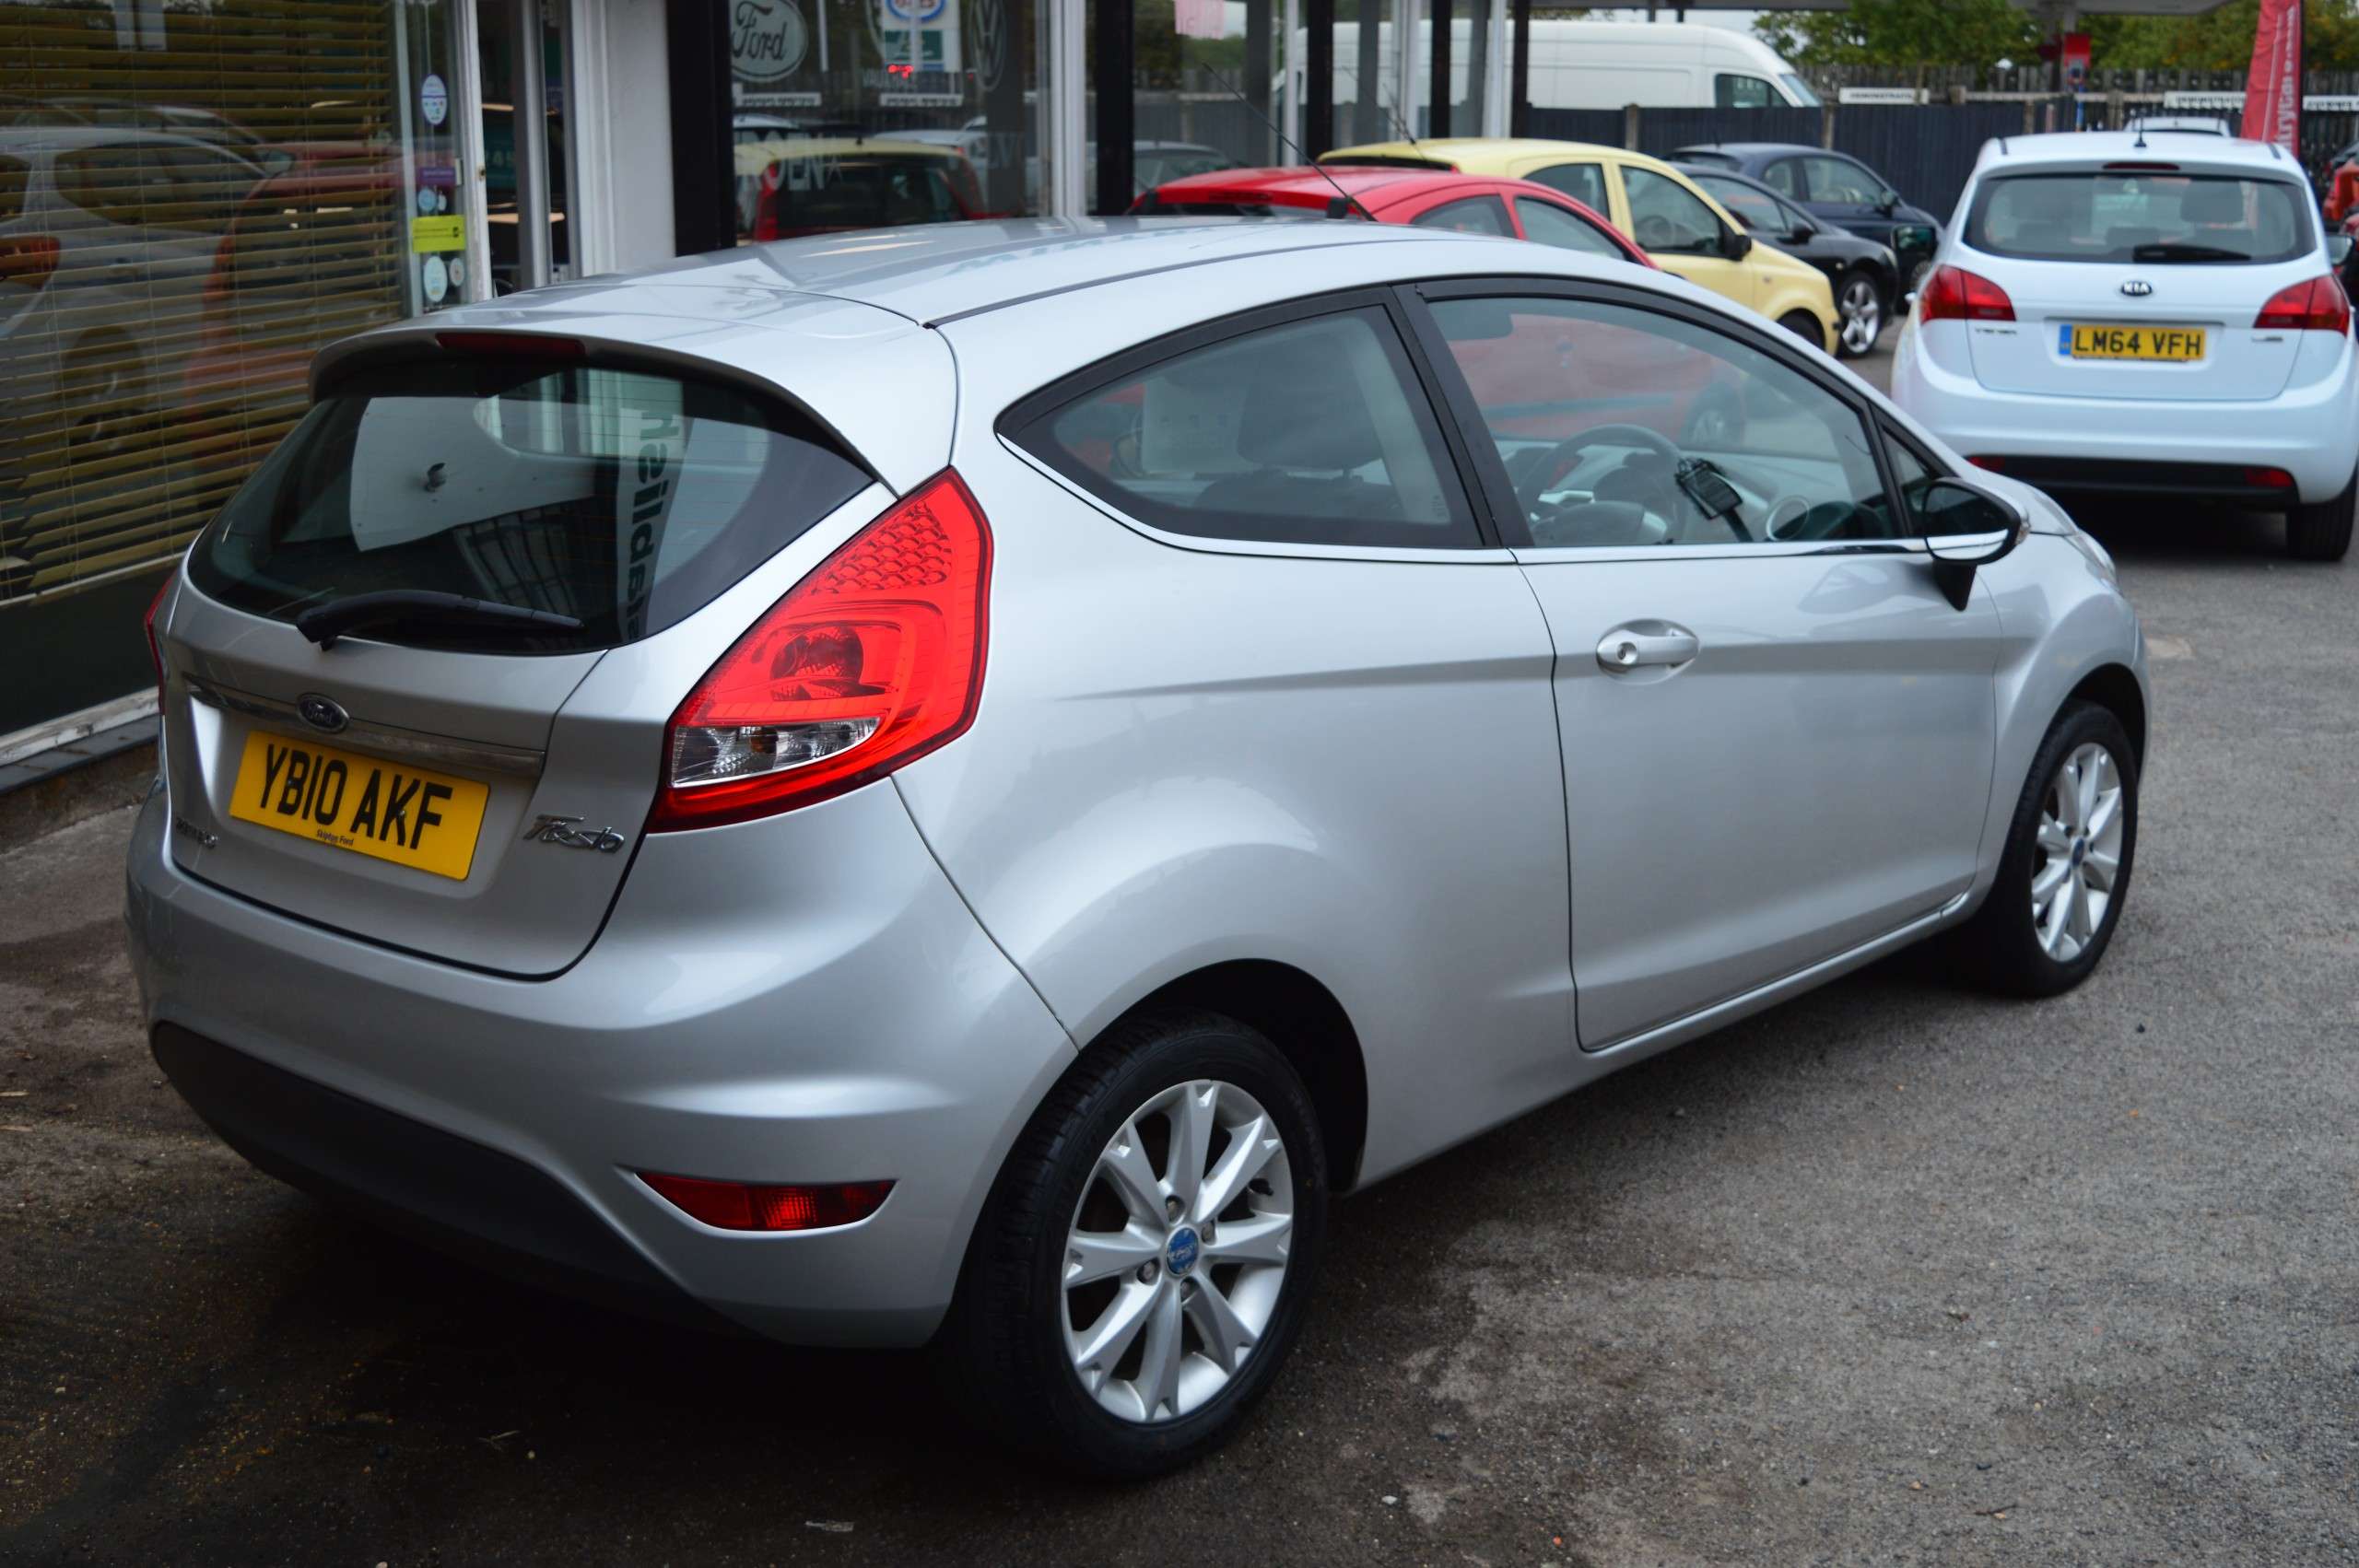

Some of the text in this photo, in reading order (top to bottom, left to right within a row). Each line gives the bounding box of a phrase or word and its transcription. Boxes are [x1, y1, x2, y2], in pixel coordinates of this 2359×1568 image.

[732, 2, 788, 62] Ford
[2122, 281, 2151, 294] KIA
[2074, 330, 2201, 357] LM64 VFH
[259, 743, 453, 849] YB10 AKF
[522, 814, 626, 853] Fiesta
